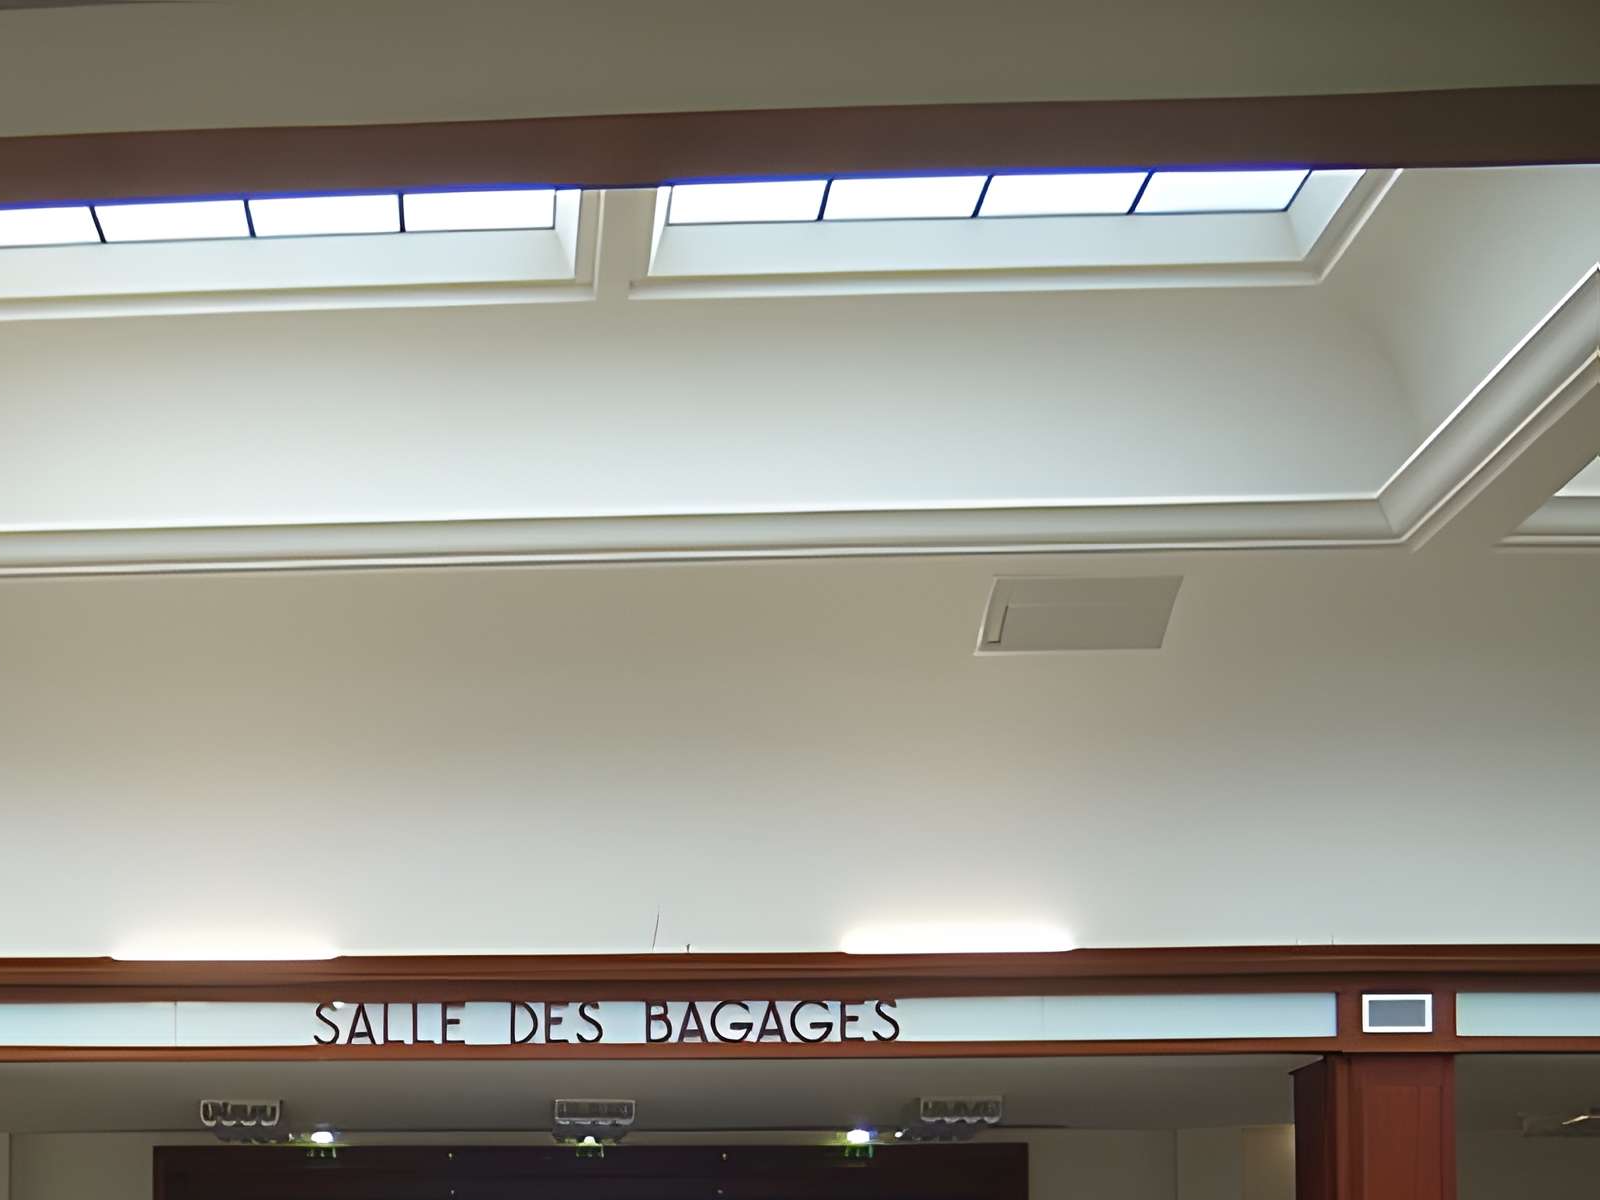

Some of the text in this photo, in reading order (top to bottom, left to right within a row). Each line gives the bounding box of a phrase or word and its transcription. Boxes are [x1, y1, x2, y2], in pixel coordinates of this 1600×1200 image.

[313, 999, 901, 1045] SALLE DES BAGAGES
